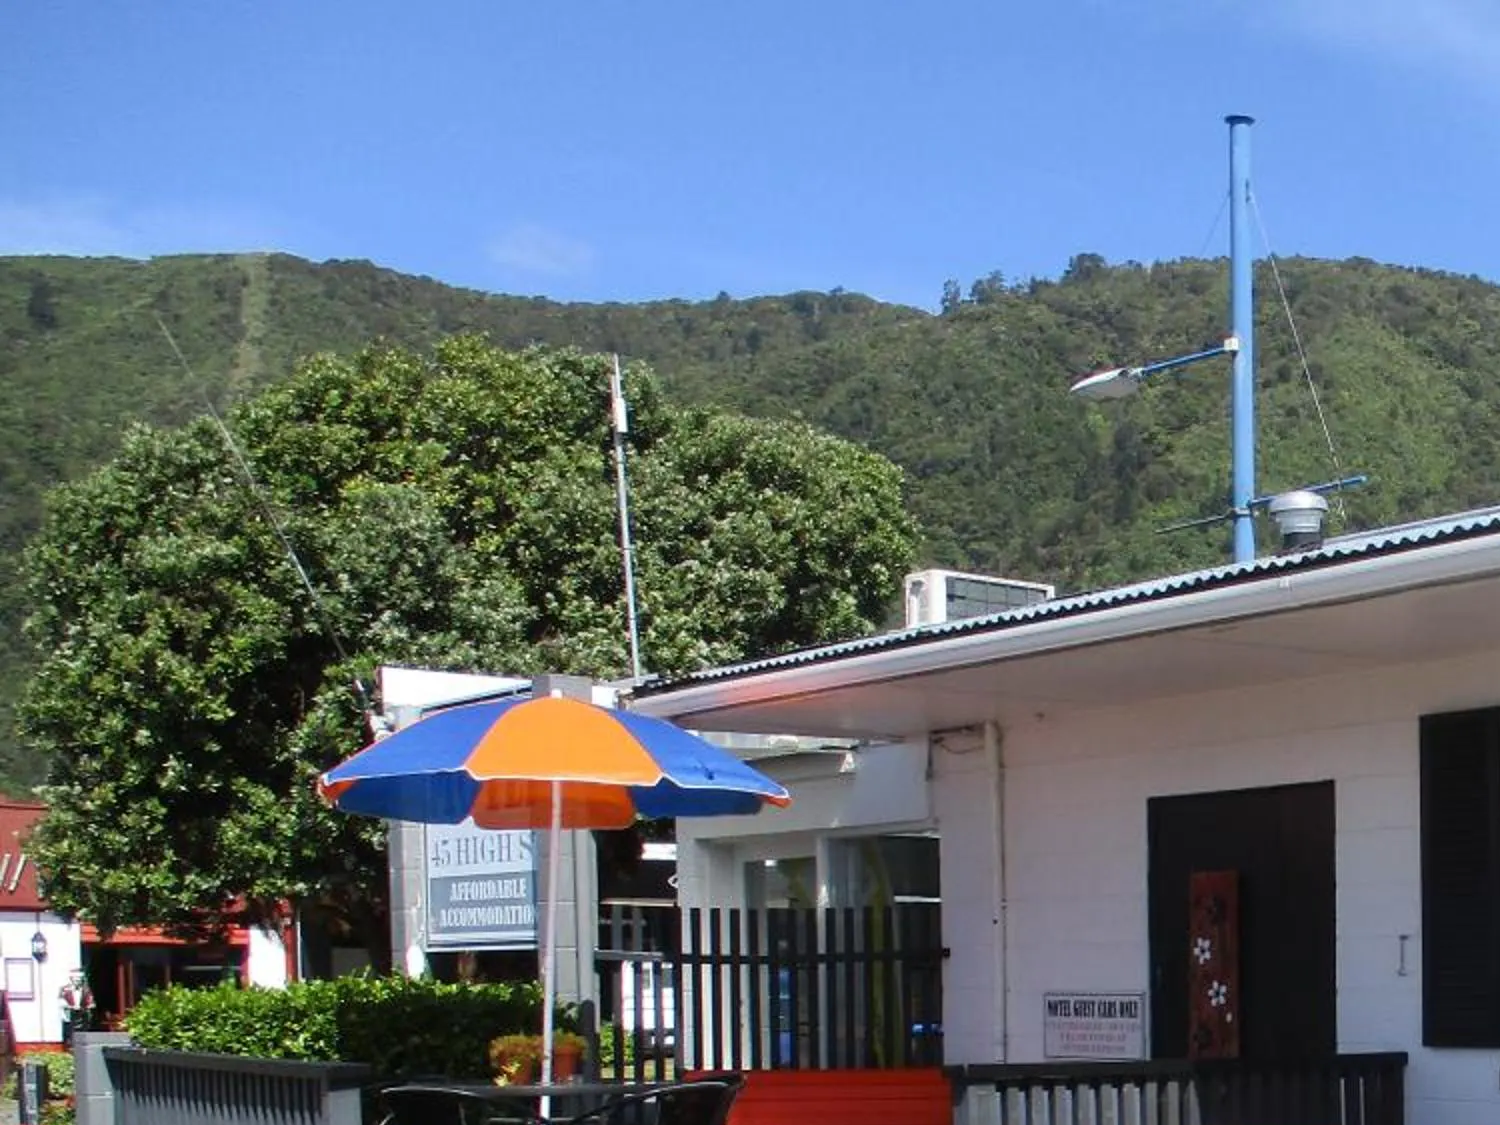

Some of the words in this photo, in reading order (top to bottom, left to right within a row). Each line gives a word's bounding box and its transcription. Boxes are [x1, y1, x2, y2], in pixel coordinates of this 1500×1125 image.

[431, 836, 451, 866] 45
[456, 833, 511, 865] HIGH
[450, 878, 527, 901] AFFORDABLE
[440, 904, 535, 927] ACCOMMODATIO
